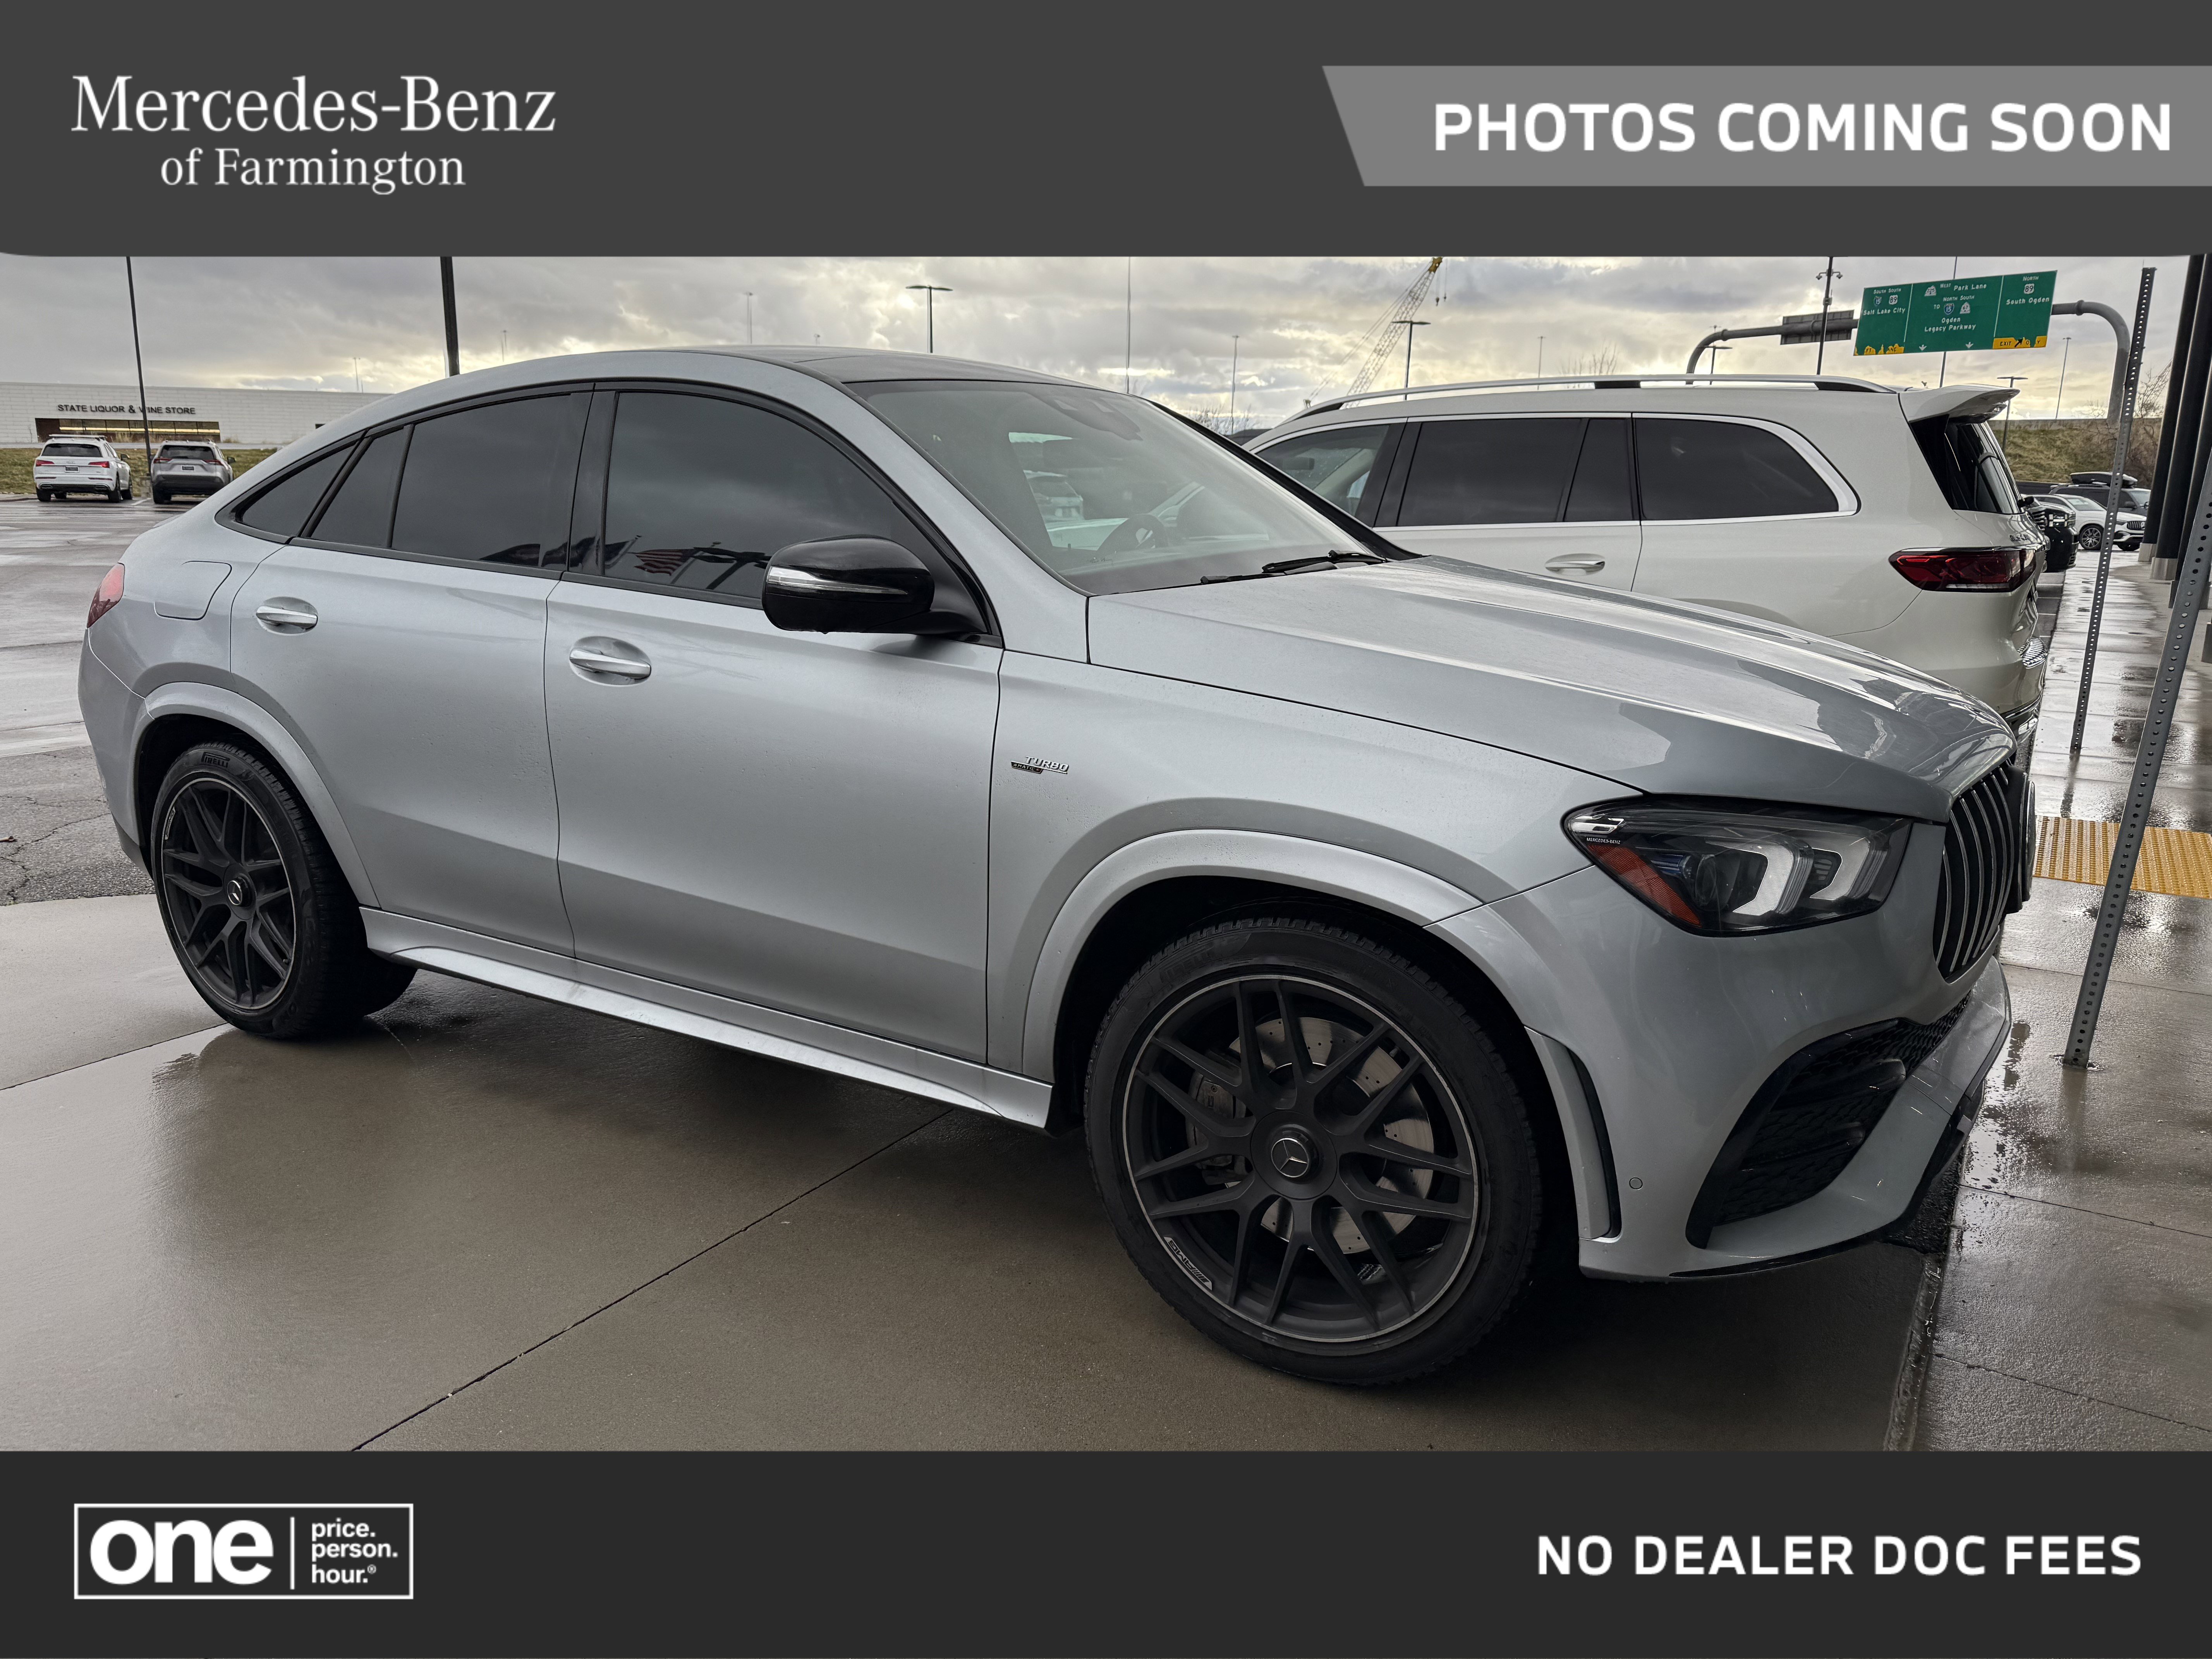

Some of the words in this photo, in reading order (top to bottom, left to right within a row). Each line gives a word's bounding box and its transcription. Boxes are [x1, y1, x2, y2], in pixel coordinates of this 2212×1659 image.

[129, 405, 136, 413] &
[201, 752, 230, 768] PIRELLI
[1025, 756, 1069, 772] TURBO
